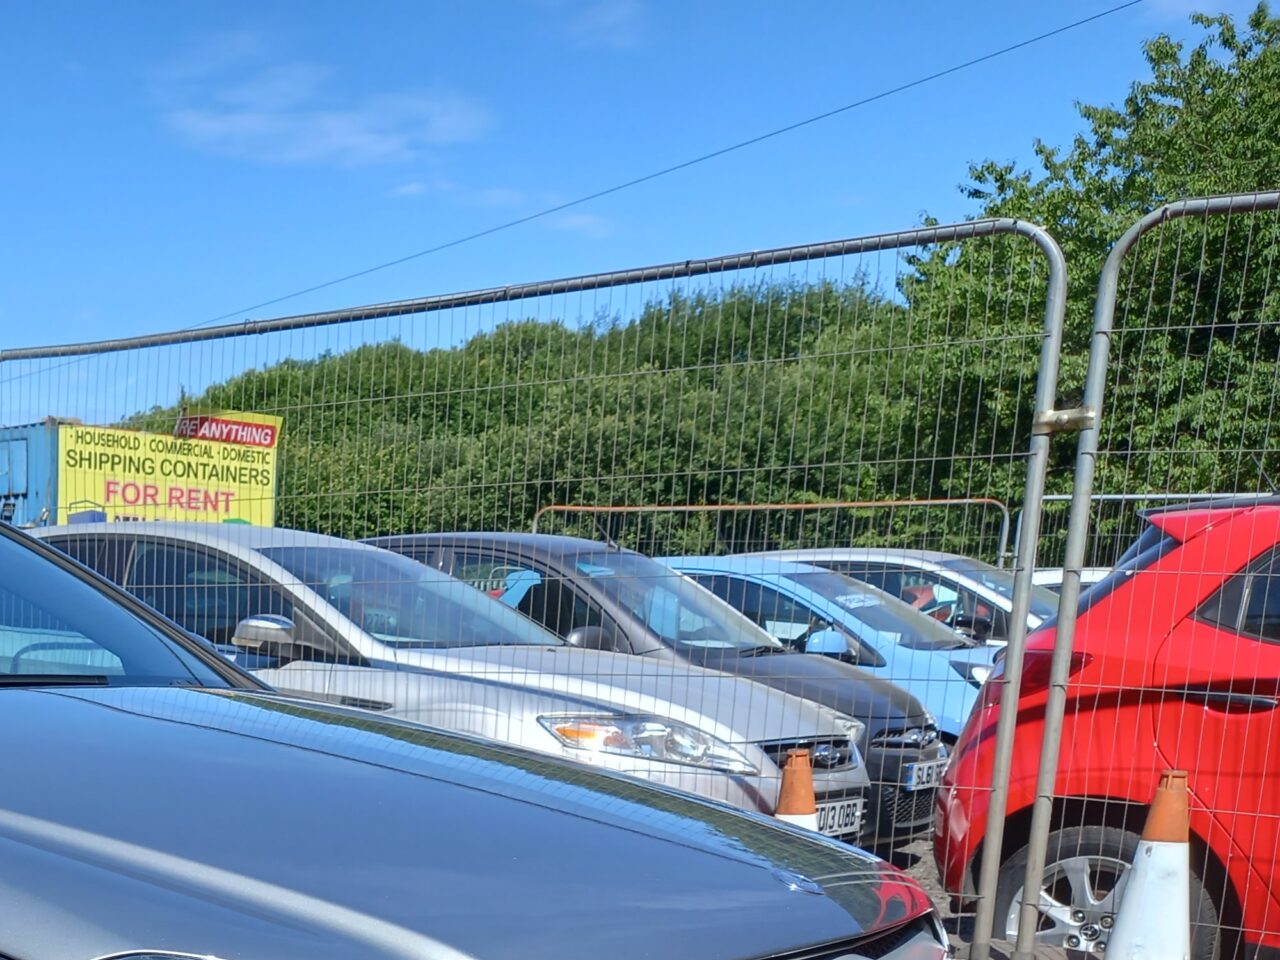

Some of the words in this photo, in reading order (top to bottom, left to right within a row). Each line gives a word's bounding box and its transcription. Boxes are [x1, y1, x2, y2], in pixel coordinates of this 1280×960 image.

[76, 431, 140, 451] HOUSEHOLD
[149, 438, 214, 460] COMMERCIAL
[222, 449, 271, 465] DOMESTIC
[198, 421, 273, 445] ANYTHING
[66, 450, 154, 475] SHIPPING
[160, 458, 270, 486] CONTAINERS
[105, 481, 159, 506] FOR
[168, 486, 235, 513] RENT
[816, 805, 837, 832] D13
